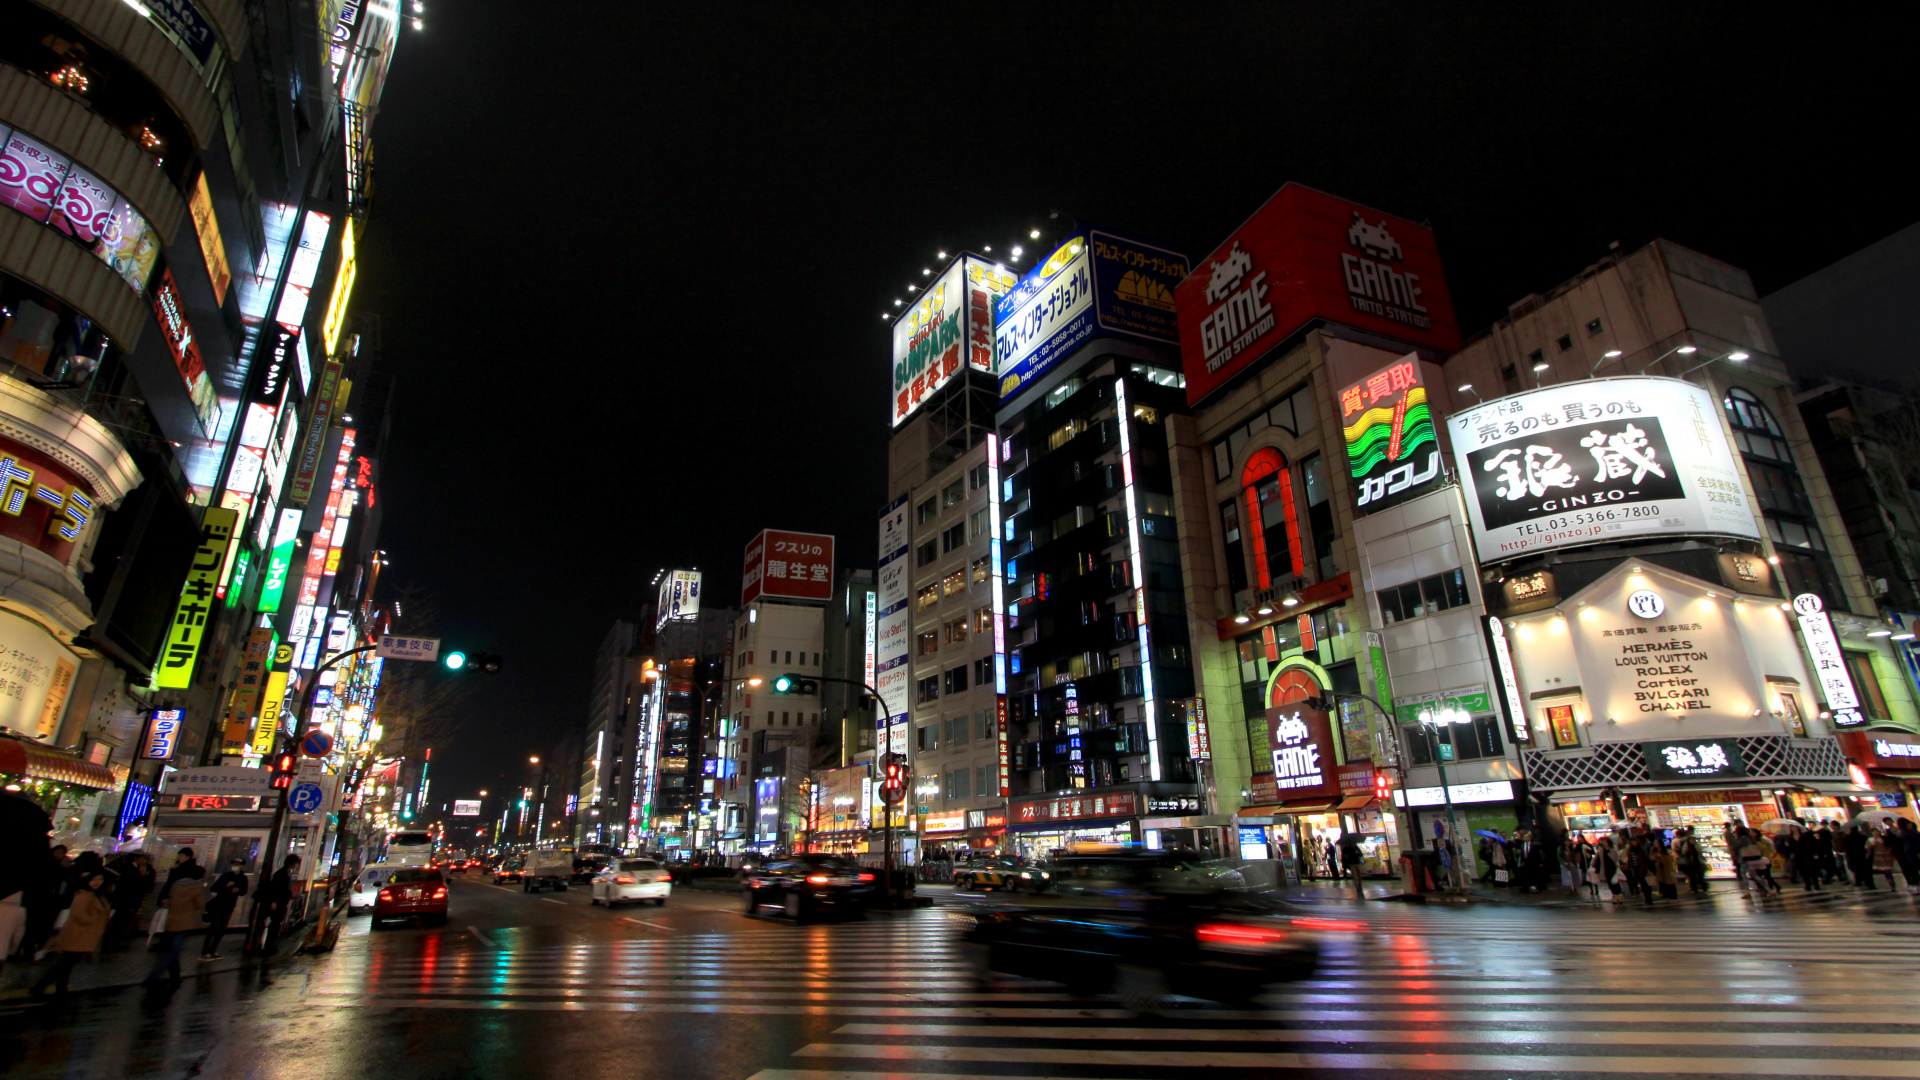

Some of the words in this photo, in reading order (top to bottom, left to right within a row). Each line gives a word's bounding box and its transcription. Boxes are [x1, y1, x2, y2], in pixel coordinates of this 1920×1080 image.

[10, 138, 108, 203] 高収入求人サイト
[1341, 251, 1428, 314] GAME
[997, 265, 1089, 366] アムス・インターナショナル
[1112, 305, 1127, 316] TEL
[1200, 269, 1272, 361] GAME
[1351, 296, 1383, 317] TAITO
[1386, 306, 1432, 330] STATION
[895, 306, 961, 392] SUNPARK
[1205, 347, 1233, 375] TAITO
[1233, 312, 1275, 355] STATION
[1458, 400, 1524, 430] ブランド品
[1477, 411, 1560, 445] 売るのも
[1562, 399, 1644, 424] 買うのも
[1357, 450, 1440, 507] カワノ
[775, 541, 823, 556] クスリの
[1500, 523, 1603, 553] http://ginzo.jp
[265, 557, 287, 590] レイク
[766, 559, 829, 582] 龍生堂
[165, 523, 229, 669] ドン・キホーテ
[383, 637, 435, 651] 歌舞伎町
[1602, 627, 1649, 638] 高価買取
[390, 649, 424, 657] Kabukicho
[1622, 637, 1694, 655] HERMÈS
[1615, 656, 1650, 667] LOUIS
[1654, 651, 1709, 664] VUITTON
[1635, 664, 1694, 677] ROLEX
[242, 660, 263, 686] 麻雀
[1637, 676, 1699, 690] Cartier
[1634, 688, 1710, 702] BVLGARI
[1639, 700, 1712, 713] CHANEL
[258, 700, 279, 741] プロミス
[1554, 707, 1566, 718] 2F
[148, 721, 176, 757] ダイコク
[1272, 743, 1321, 778] GAME
[1277, 778, 1296, 790] TAITO
[1296, 774, 1323, 788] STATION
[187, 795, 229, 809] 下さい
[294, 789, 311, 809] P
[1022, 806, 1049, 818] クスリの
